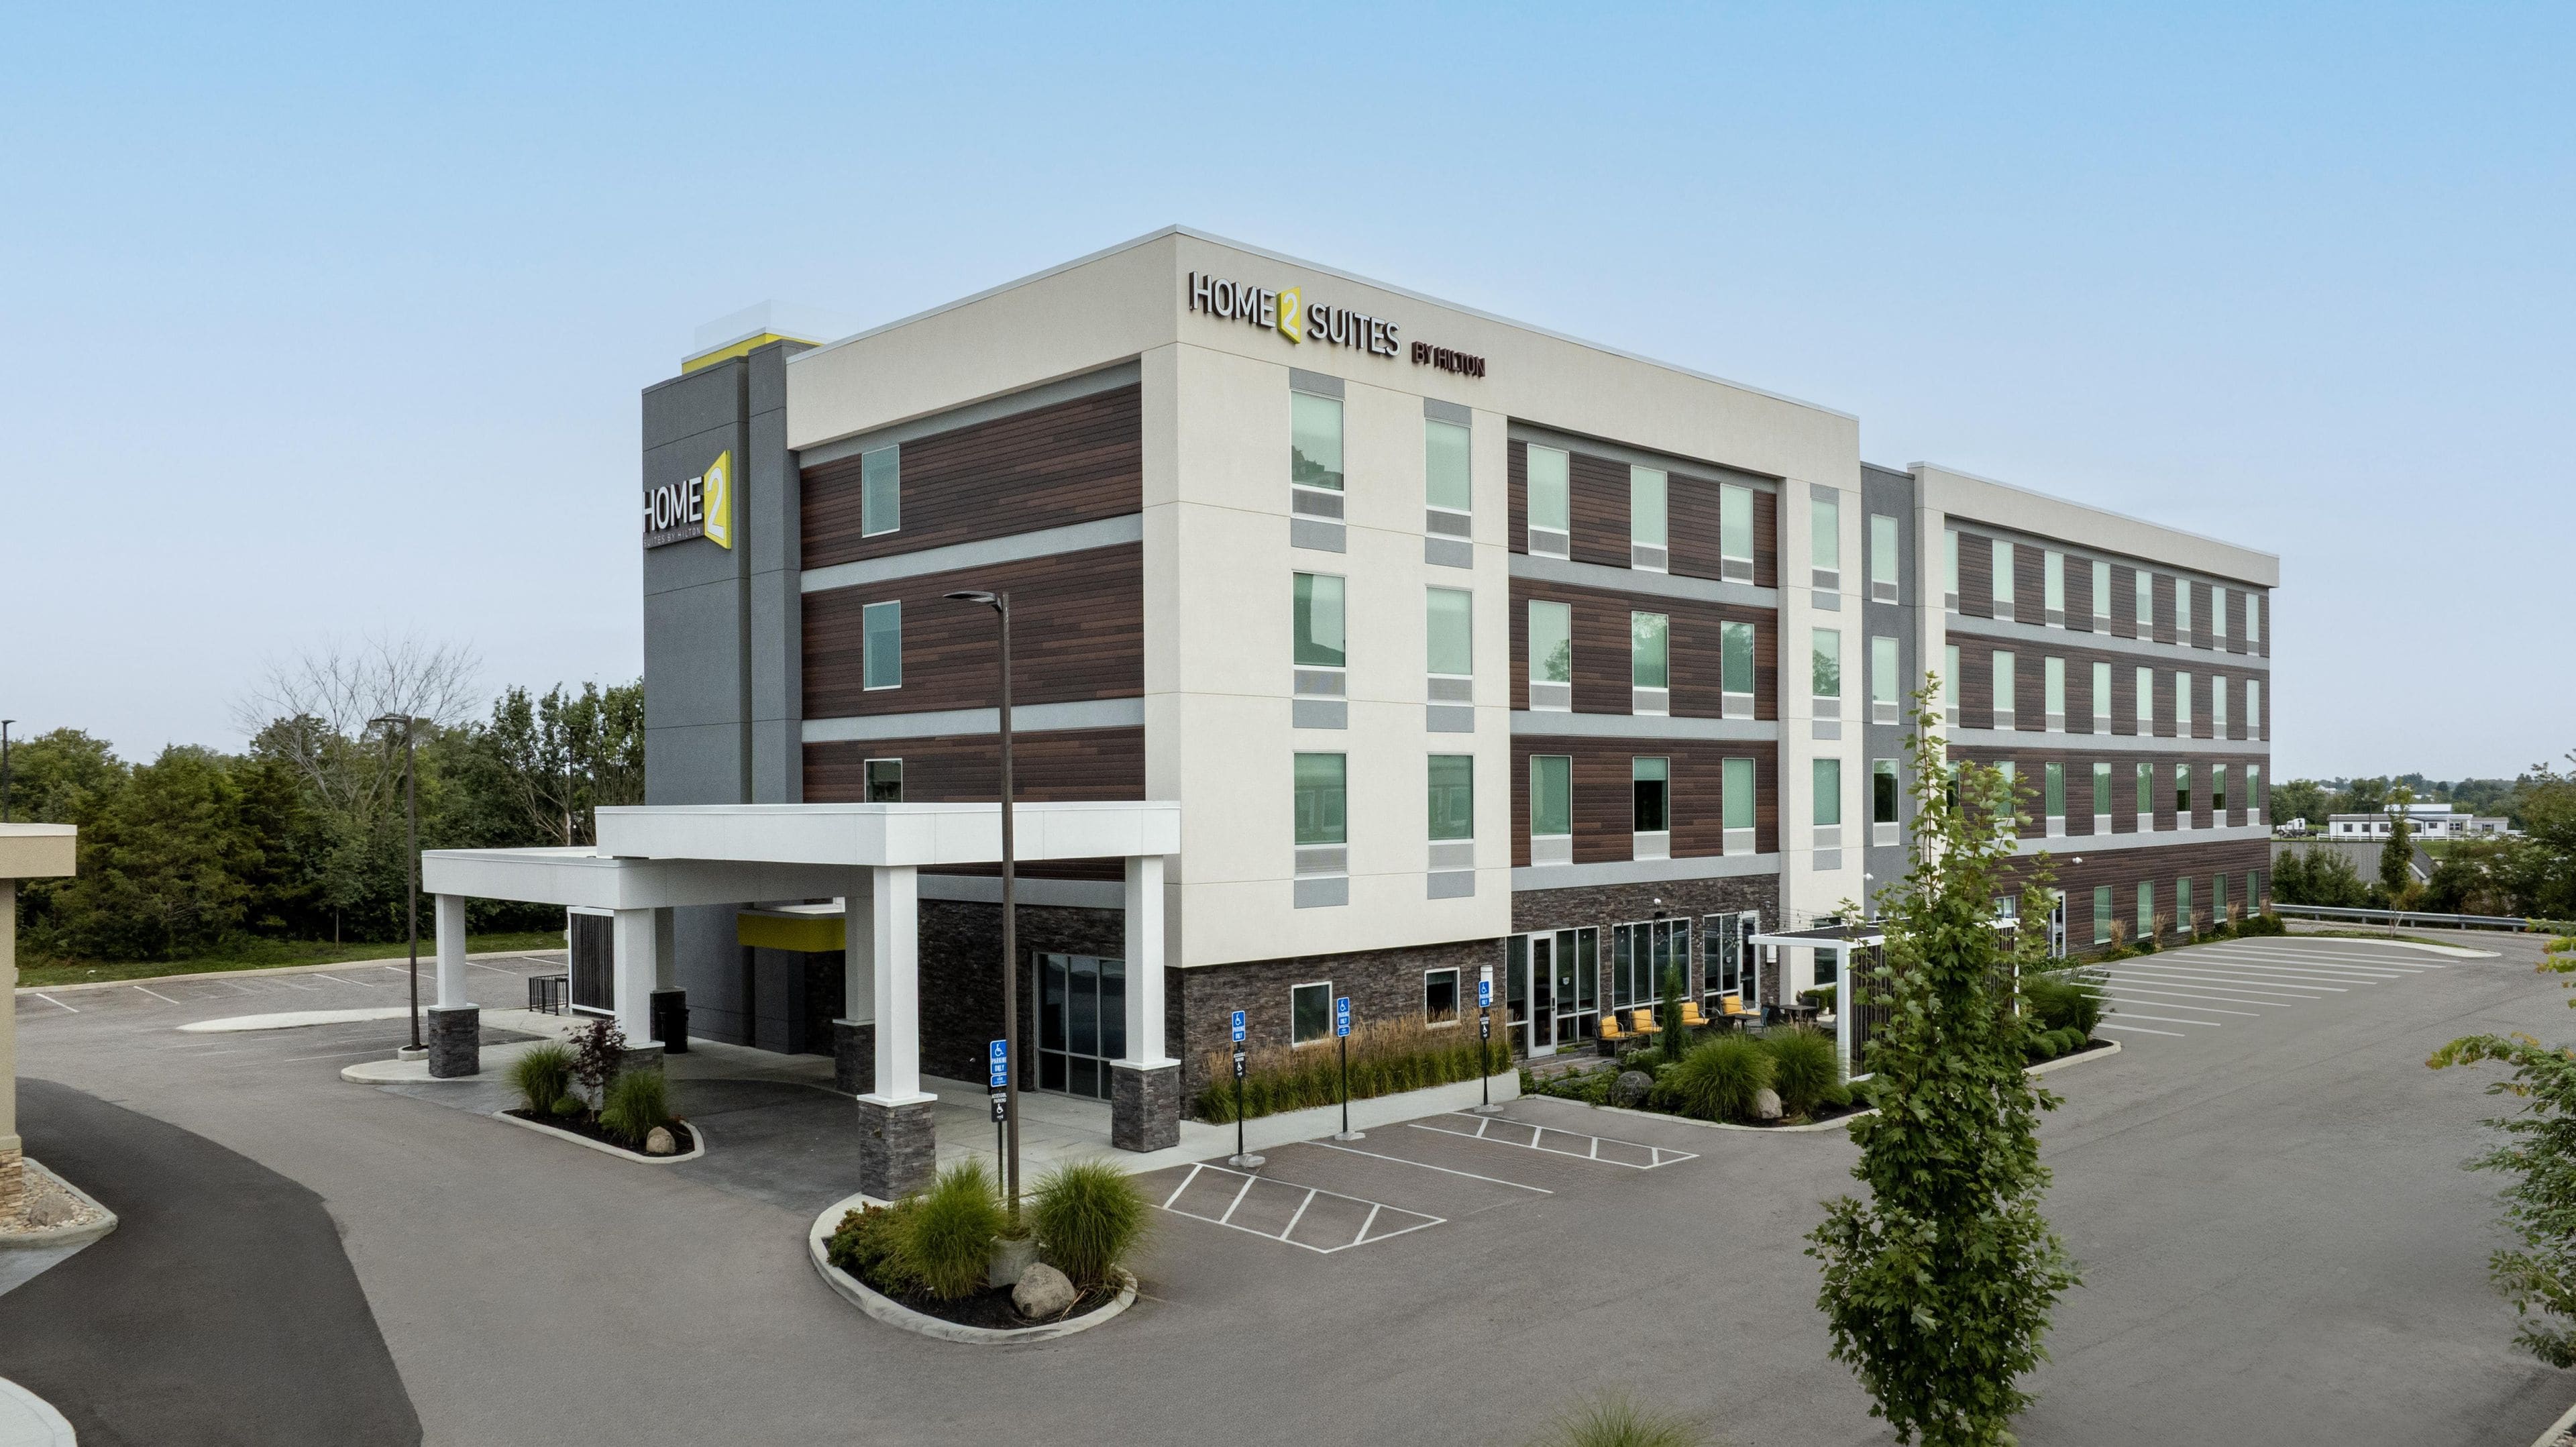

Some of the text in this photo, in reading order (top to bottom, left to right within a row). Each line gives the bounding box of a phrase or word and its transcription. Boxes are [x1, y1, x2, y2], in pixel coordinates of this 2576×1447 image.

[1307, 302, 1401, 357] SUITES
[1411, 341, 1434, 365] BY
[1434, 347, 1486, 378] HILTON
[644, 527, 700, 547] SUITES BY HILTON
[991, 1057, 1007, 1065] PARKIN
